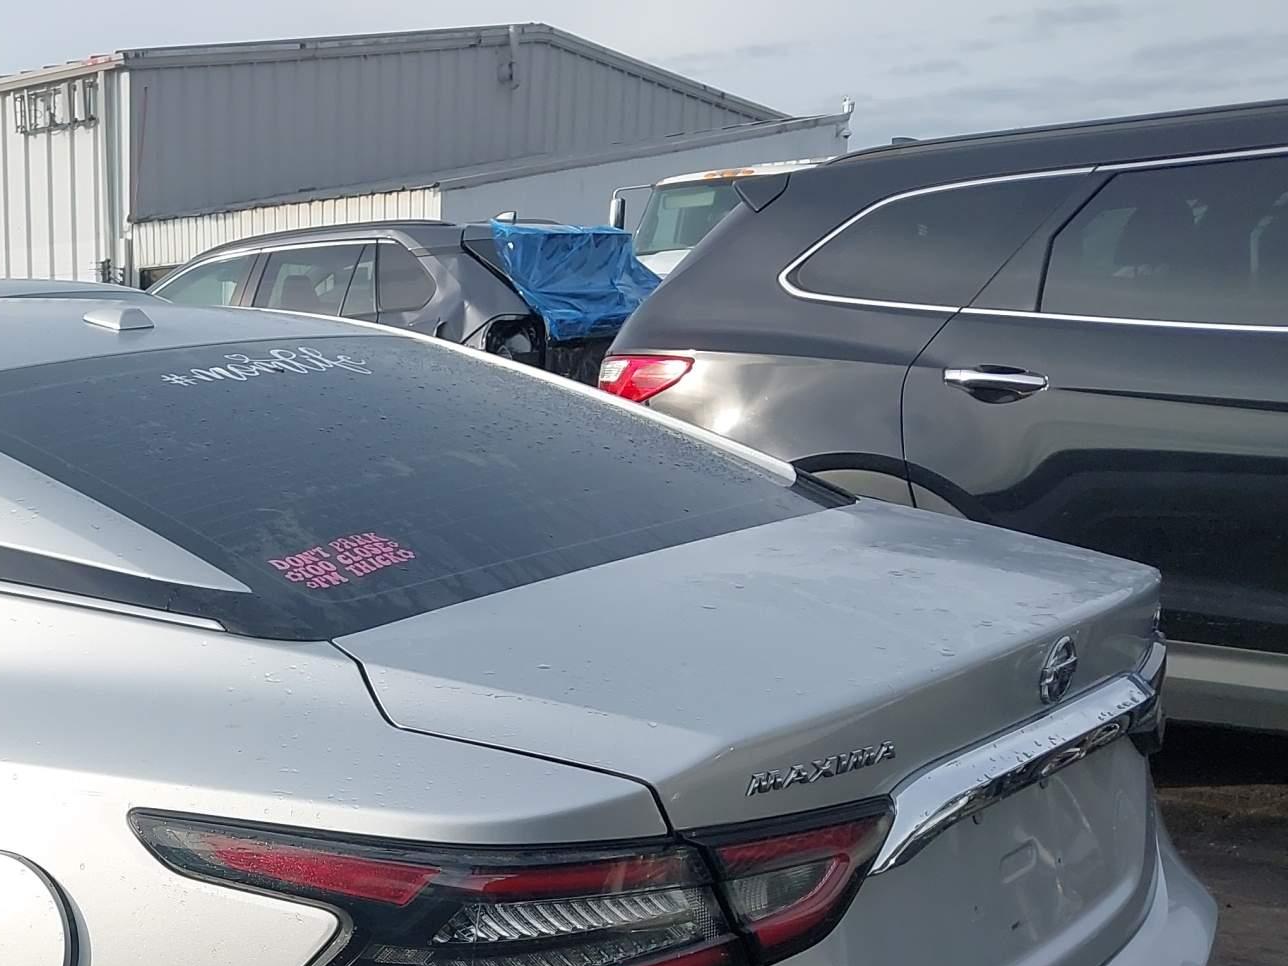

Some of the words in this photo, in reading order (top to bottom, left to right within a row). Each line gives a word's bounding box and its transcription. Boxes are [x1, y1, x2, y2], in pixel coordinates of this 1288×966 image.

[161, 346, 373, 387] #momlife
[267, 546, 331, 571] DON'T
[328, 531, 390, 553] PARK
[297, 559, 338, 579] TOO
[336, 542, 390, 566] CLOSE
[315, 572, 350, 589] I'M
[345, 551, 408, 578] THICK
[745, 740, 896, 797] MAXIMA
